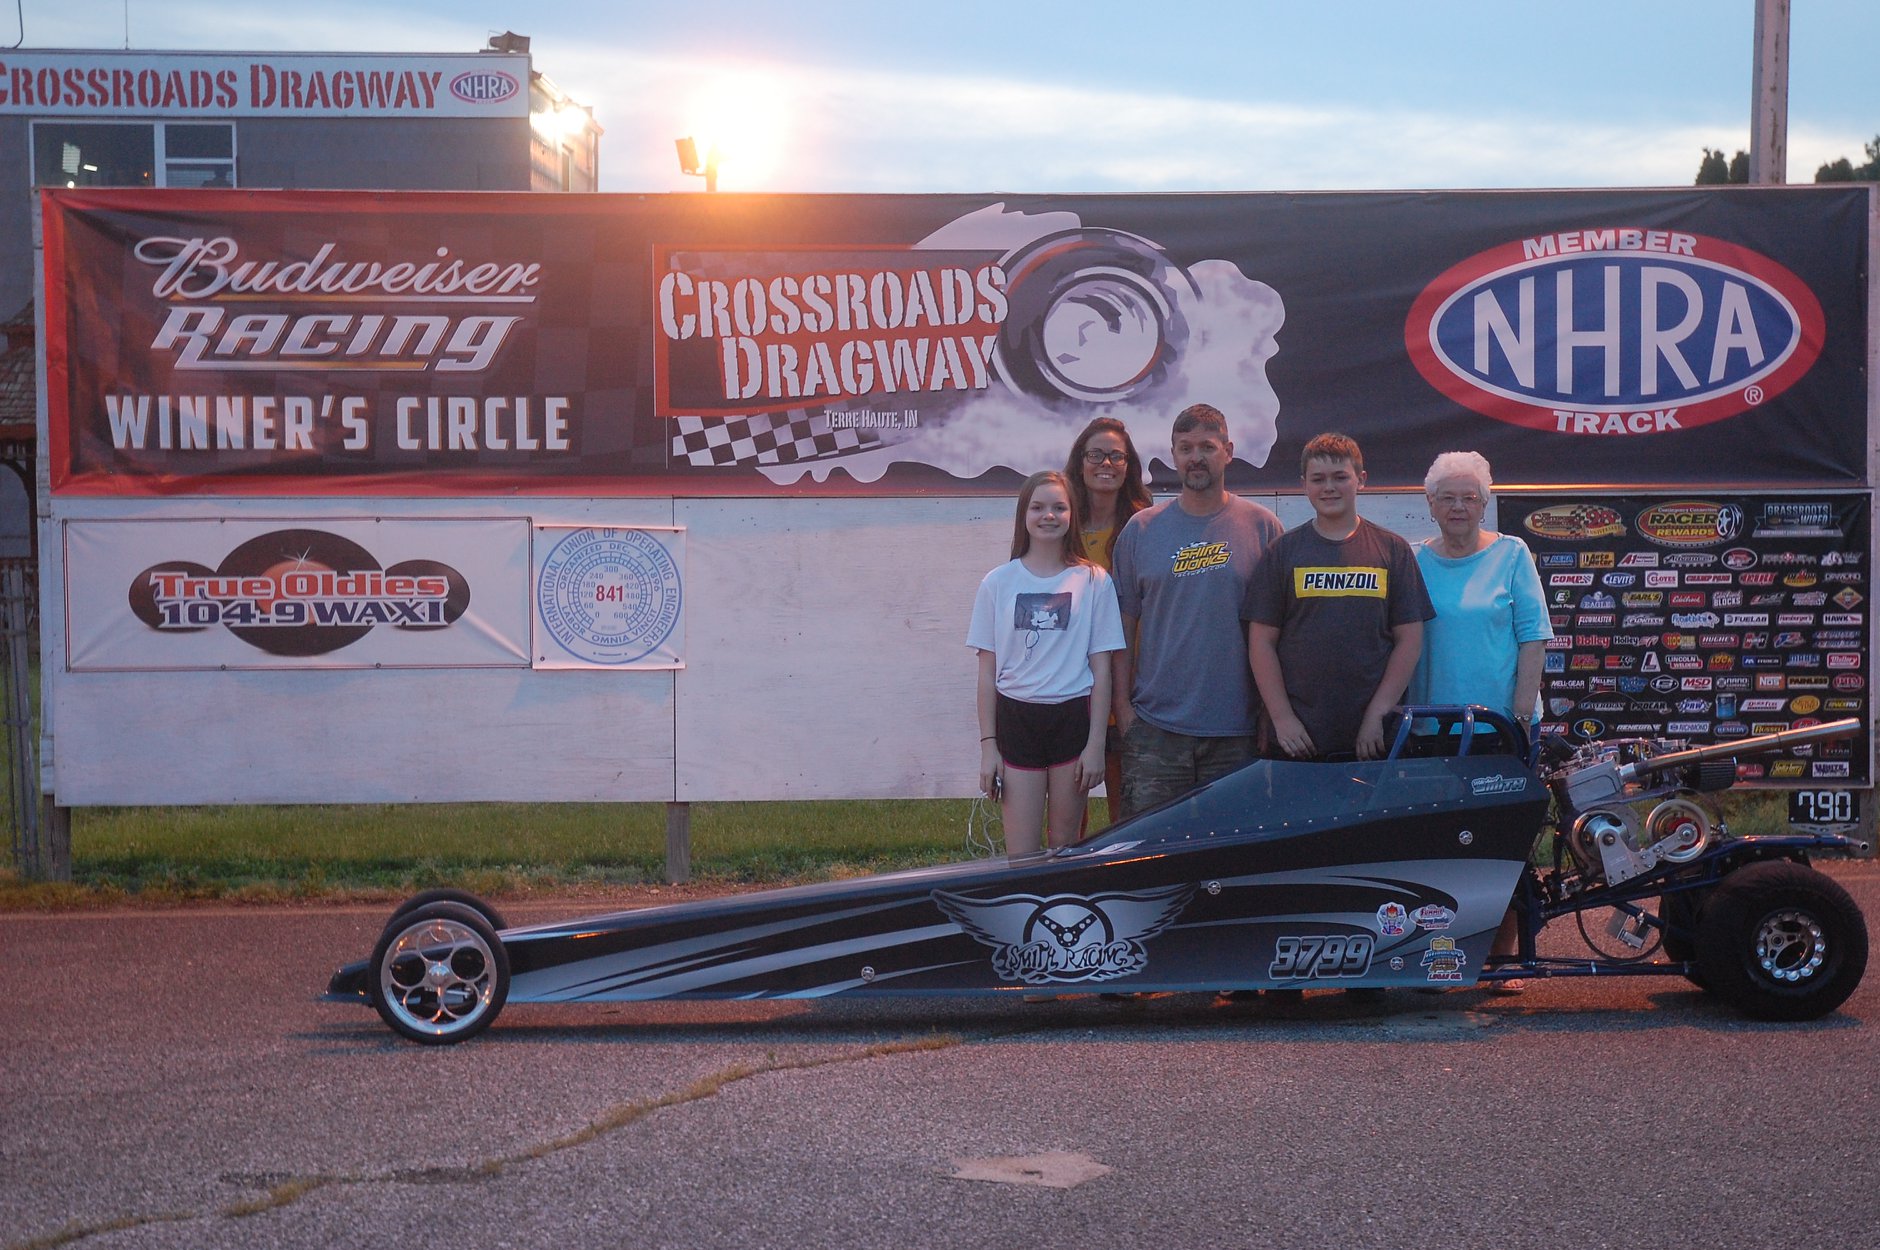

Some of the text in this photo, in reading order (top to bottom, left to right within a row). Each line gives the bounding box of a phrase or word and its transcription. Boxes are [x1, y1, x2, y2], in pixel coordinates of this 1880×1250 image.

[250, 64, 442, 110] DRAGWAY
[460, 76, 510, 98] NHRA
[1522, 230, 1697, 260] MEMBER
[134, 237, 541, 299] Budweiser
[659, 266, 1008, 340] CROSSROADS
[1473, 265, 1765, 397] NHRA
[722, 334, 997, 400] DRAGWAY
[105, 395, 571, 450] WINNER'S CIRCLE
[824, 410, 858, 429] TERRE
[902, 409, 918, 429] IN
[1553, 408, 1682, 434] TRACK
[1649, 513, 1718, 525] RACER
[1767, 505, 1829, 516] GRASSROOTS
[1656, 528, 1715, 537] REWARDS
[1173, 551, 1230, 573] WORKS
[1177, 543, 1226, 561] SHIRT
[559, 544, 602, 589] ORGANIZED
[648, 566, 661, 592] 1896
[604, 565, 619, 573] 300
[149, 569, 450, 600] True Oldies
[543, 528, 677, 647] INTERNATIONAL UNION OF OPERATING ENGINEERS
[1303, 571, 1379, 590] PENNZOIL
[1603, 575, 1635, 584] CLEVITE
[596, 585, 624, 602] 841
[1713, 597, 1741, 606] BLOCKS
[156, 598, 452, 627] 104.9 WAXI
[1578, 615, 1612, 625] FLOWMASTER
[562, 605, 657, 644] LABOR OMNIA VINCIT
[1576, 635, 1610, 648] Holley
[1613, 635, 1639, 646] Holley
[1684, 678, 1711, 687] MSD
[1789, 677, 1828, 685] PAINLESS
[1798, 791, 1851, 822] 7.90
[1008, 941, 1130, 971] SMITH RACING
[1270, 935, 1374, 979] 3799
